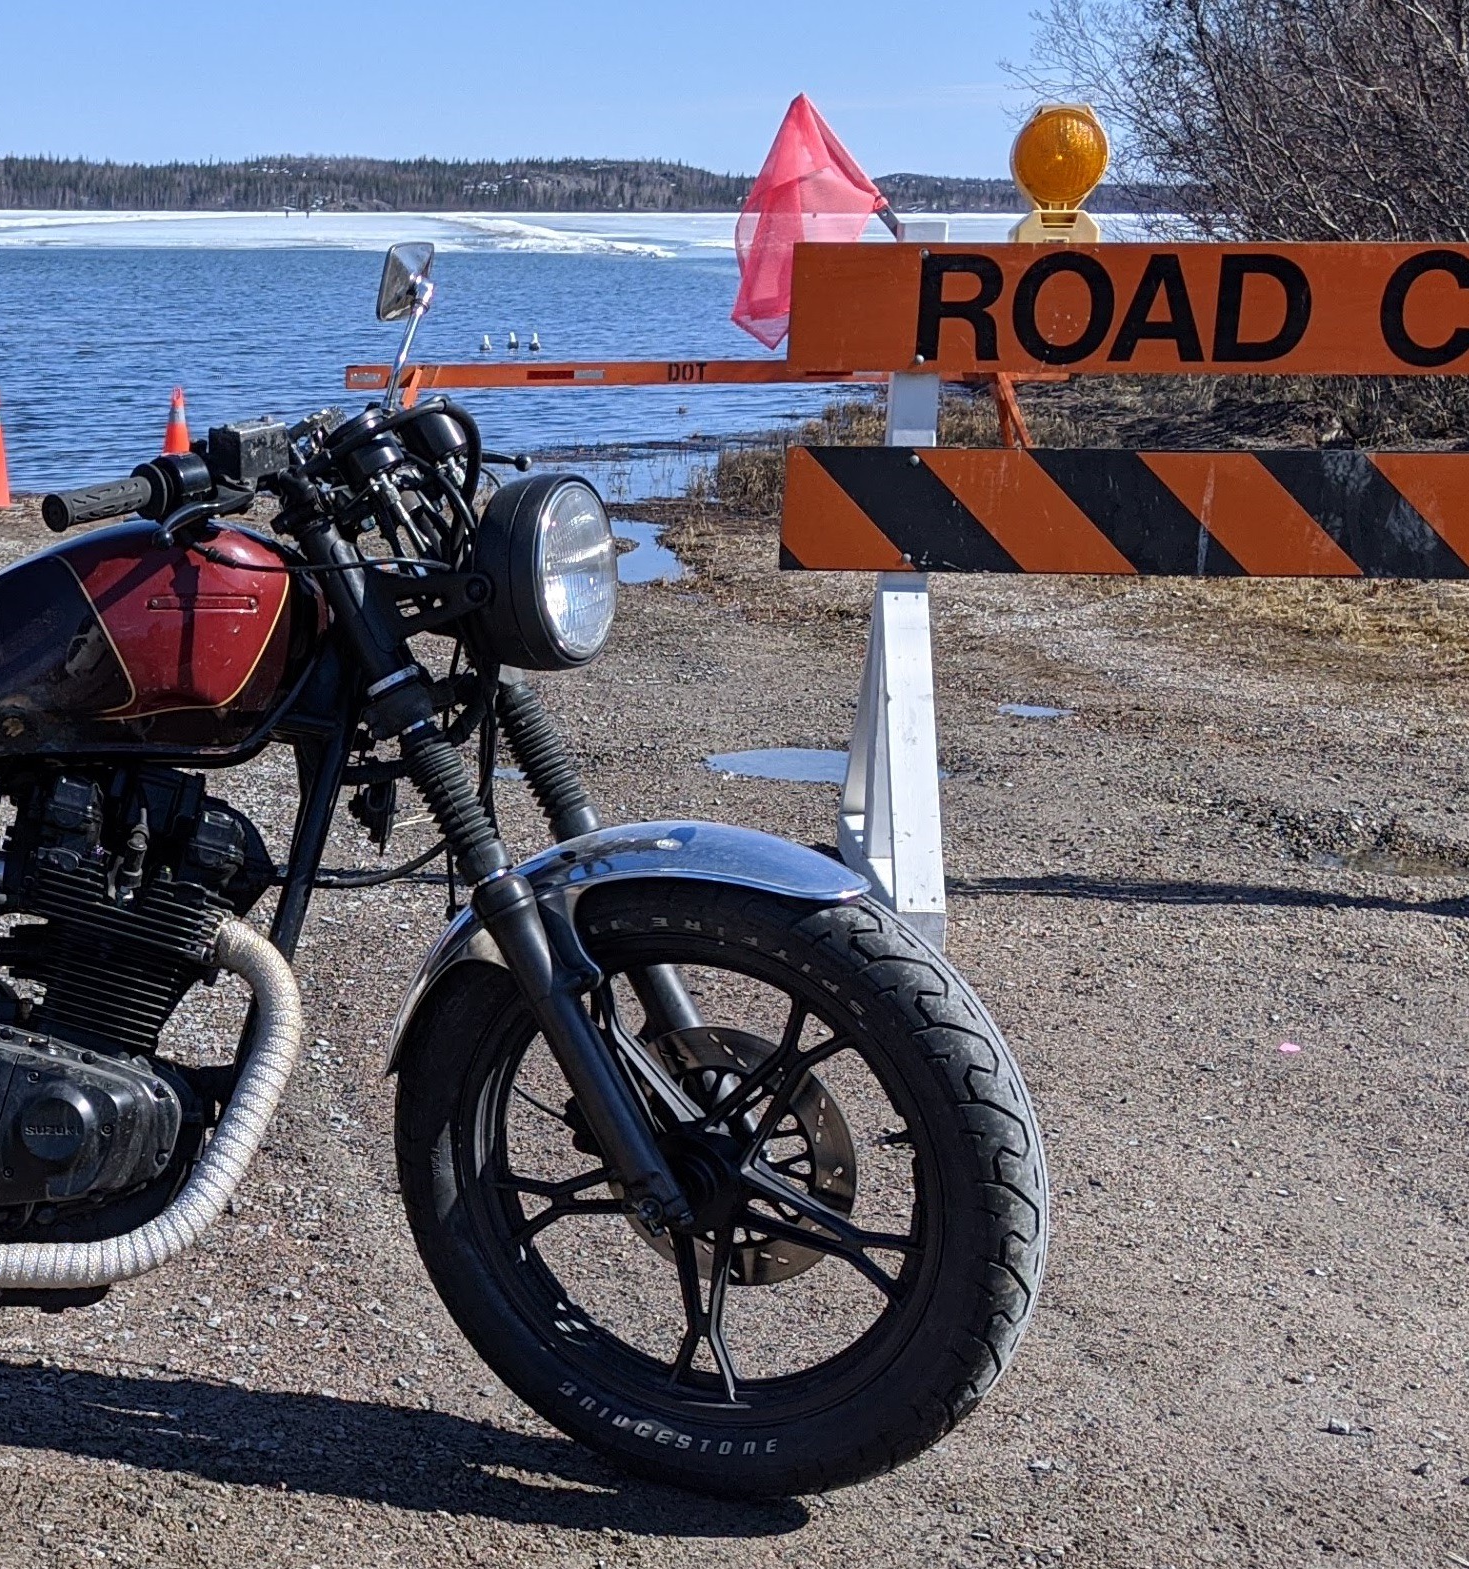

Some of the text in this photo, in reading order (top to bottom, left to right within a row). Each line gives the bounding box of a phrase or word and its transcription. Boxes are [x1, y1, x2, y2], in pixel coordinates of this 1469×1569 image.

[915, 250, 1312, 365] ROAD
[667, 361, 708, 381] DOT
[24, 1124, 81, 1136] SUZUKI
[557, 1380, 779, 1456] BRIDGESTONE
